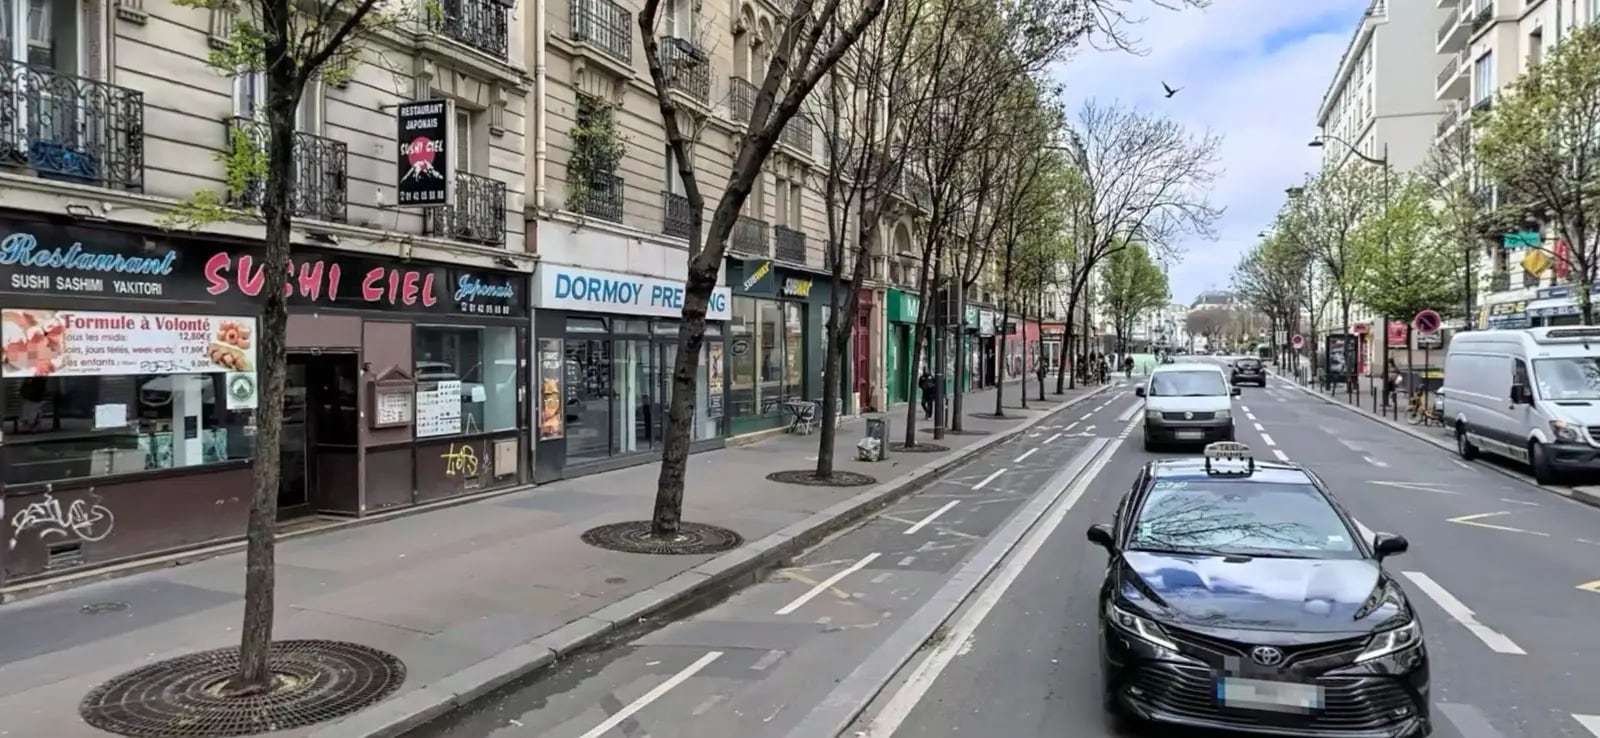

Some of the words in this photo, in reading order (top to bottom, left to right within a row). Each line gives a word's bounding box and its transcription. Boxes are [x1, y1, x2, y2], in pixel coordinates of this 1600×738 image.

[401, 104, 443, 117] RESTAURANT
[406, 118, 438, 130] JAPONAIS
[401, 141, 423, 155] SUSHI
[426, 139, 444, 153] CIEL
[0, 232, 176, 276] Restaurant
[11, 274, 50, 289] SUSHI
[56, 276, 104, 292] SASHIMI
[113, 279, 163, 295] YAKITORI
[362, 266, 437, 307] CIEL
[454, 273, 514, 301] Japonais
[555, 273, 643, 306] DORMOY
[651, 285, 725, 312] PRENG
[64, 313, 135, 330] Formule
[141, 315, 150, 330] à
[155, 316, 210, 331] Volonté
[80, 358, 115, 367] enfants
